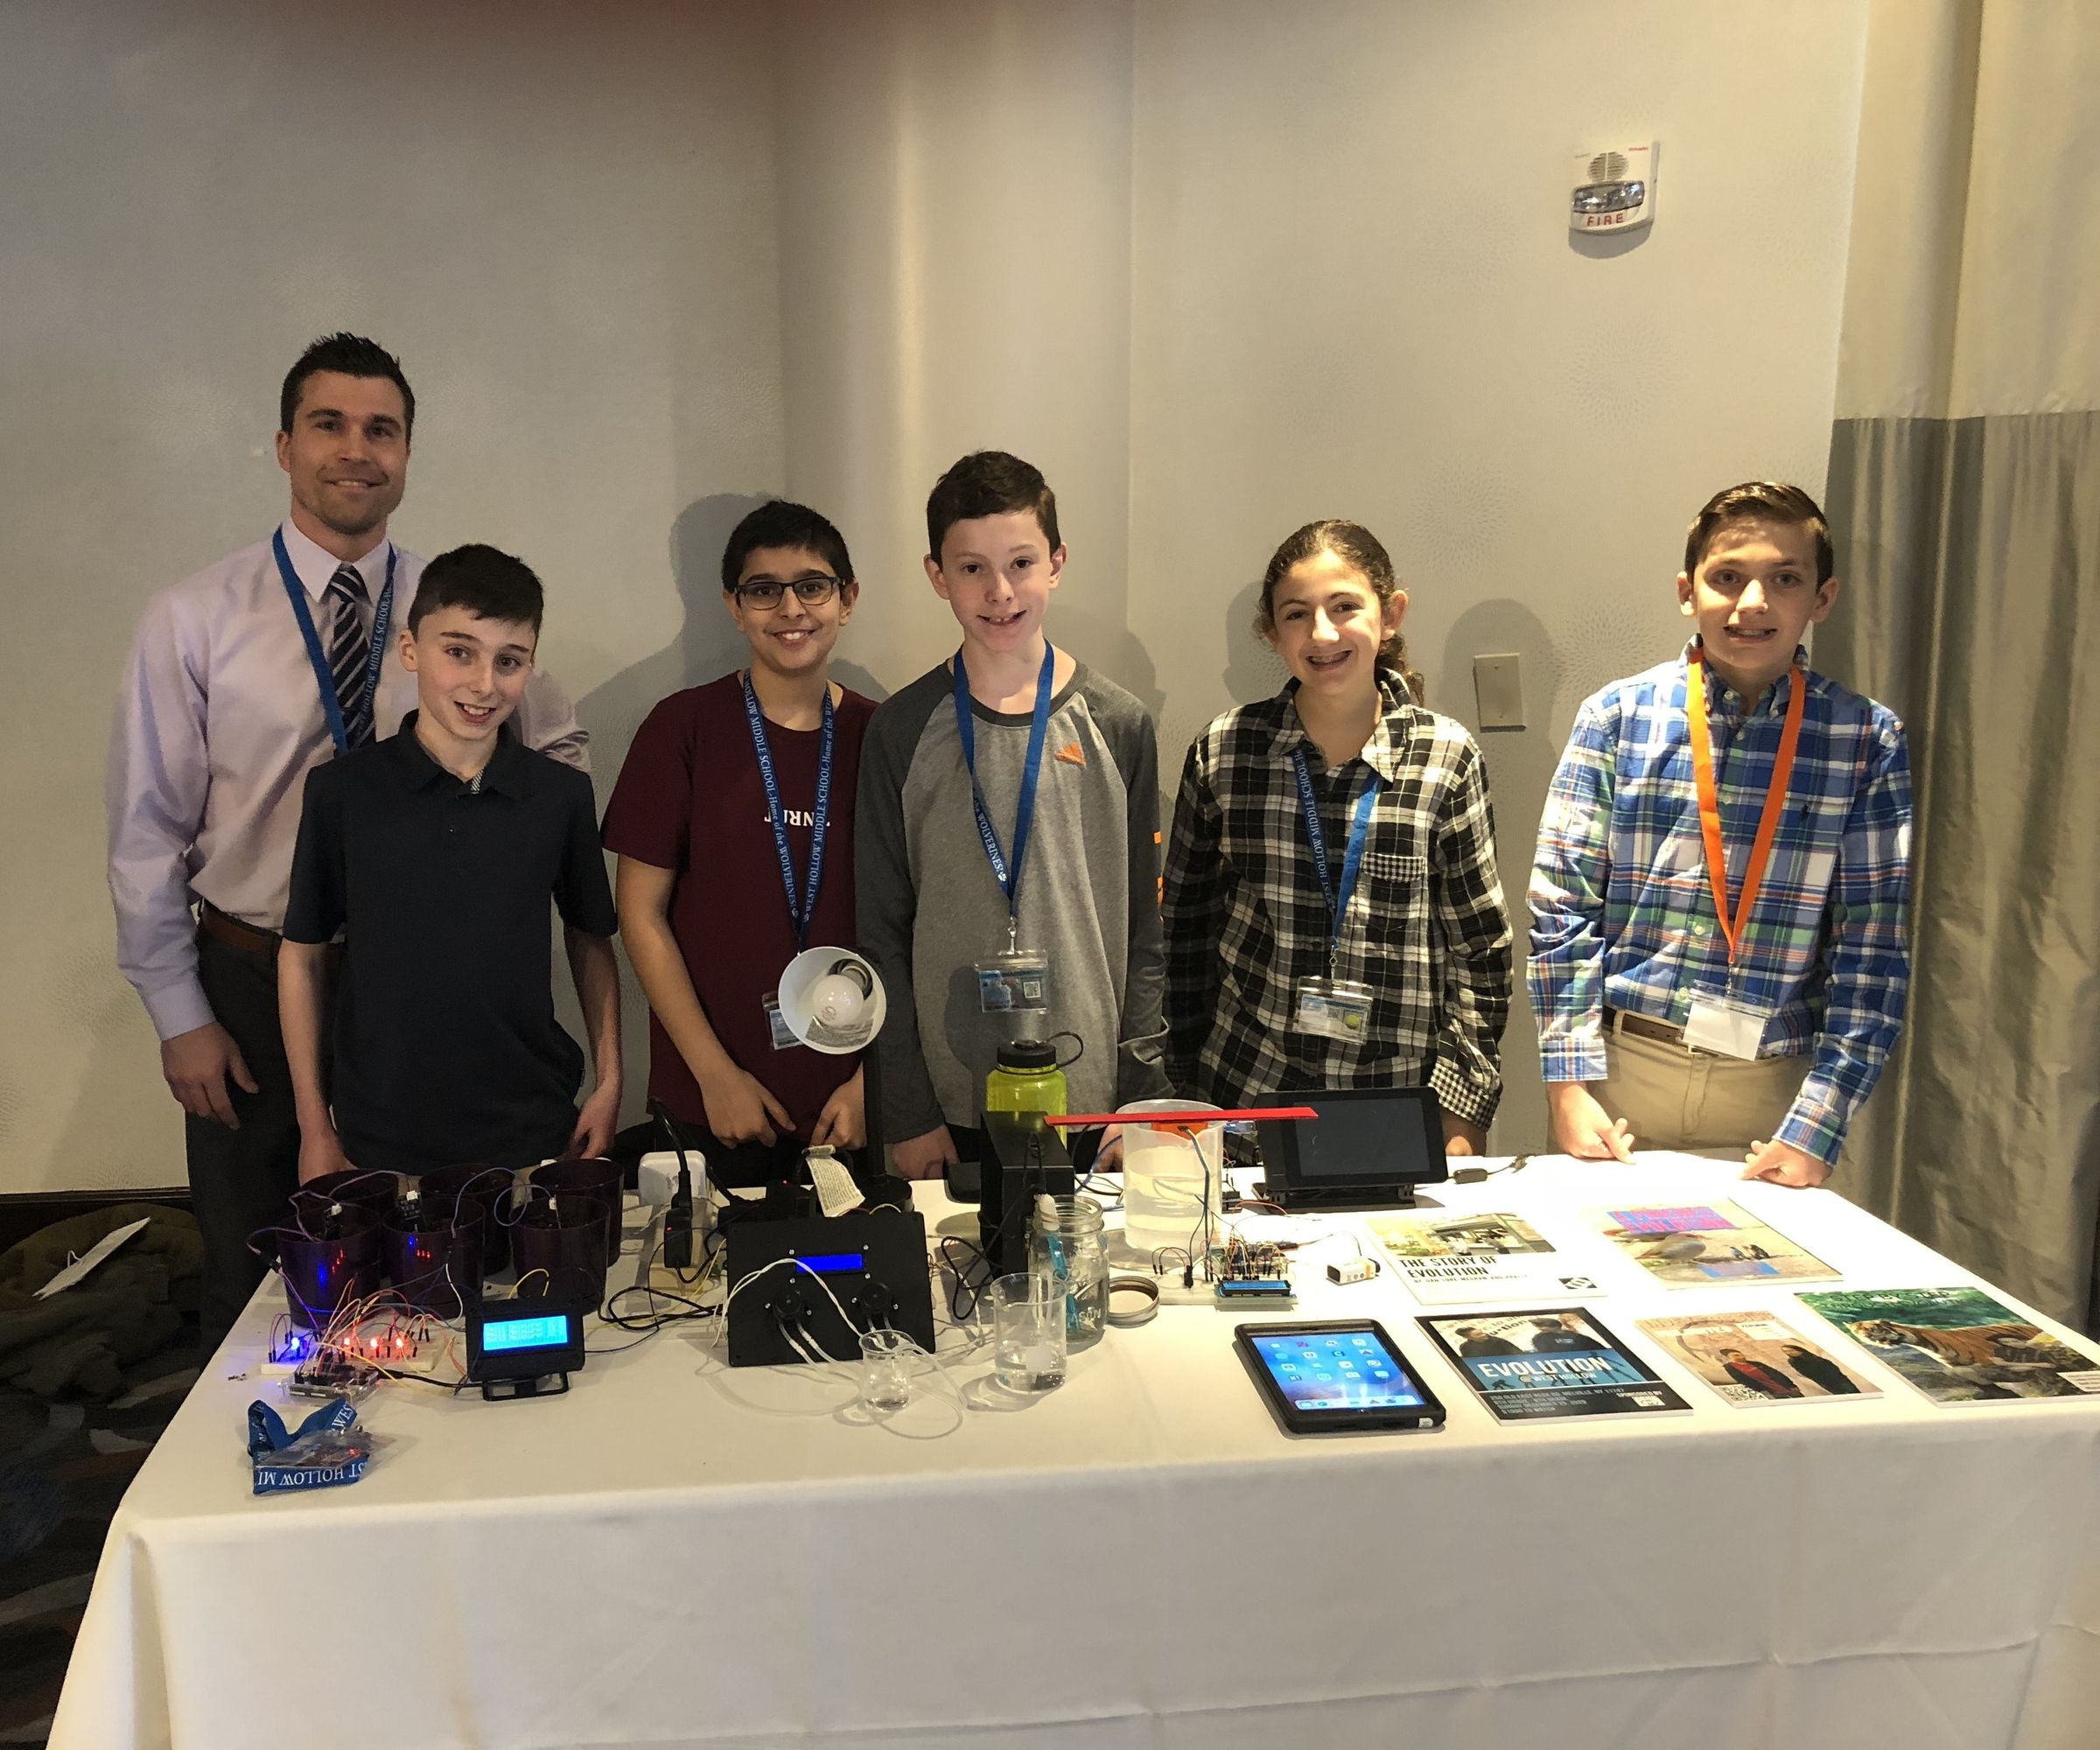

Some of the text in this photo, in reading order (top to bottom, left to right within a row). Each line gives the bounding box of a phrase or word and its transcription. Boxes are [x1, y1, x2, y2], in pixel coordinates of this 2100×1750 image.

[1586, 213, 1625, 227] FIRE
[368, 635, 383, 670] MIDDLE
[824, 718, 833, 729] the
[749, 716, 767, 753] MIDDLE
[823, 730, 833, 738] of
[773, 822, 782, 831] of
[813, 805, 826, 842] MIDDLE
[1305, 800, 1321, 836] MIDDLE
[775, 833, 786, 845] the
[977, 813, 1004, 872] WOLVERINES!
[808, 844, 822, 886] HOLLOW
[1312, 838, 1327, 878] HOLLOW
[805, 887, 816, 912] WEST
[1400, 1255, 1498, 1268] THE STORY OF
[1407, 1266, 1489, 1278] EVOLUTION
[1879, 1293, 1900, 1302] BY
[1477, 1356, 1612, 1378] EVOLUTION
[1558, 1371, 1598, 1381] HOLLOW
[279, 1467, 344, 1486] HOLLOW
